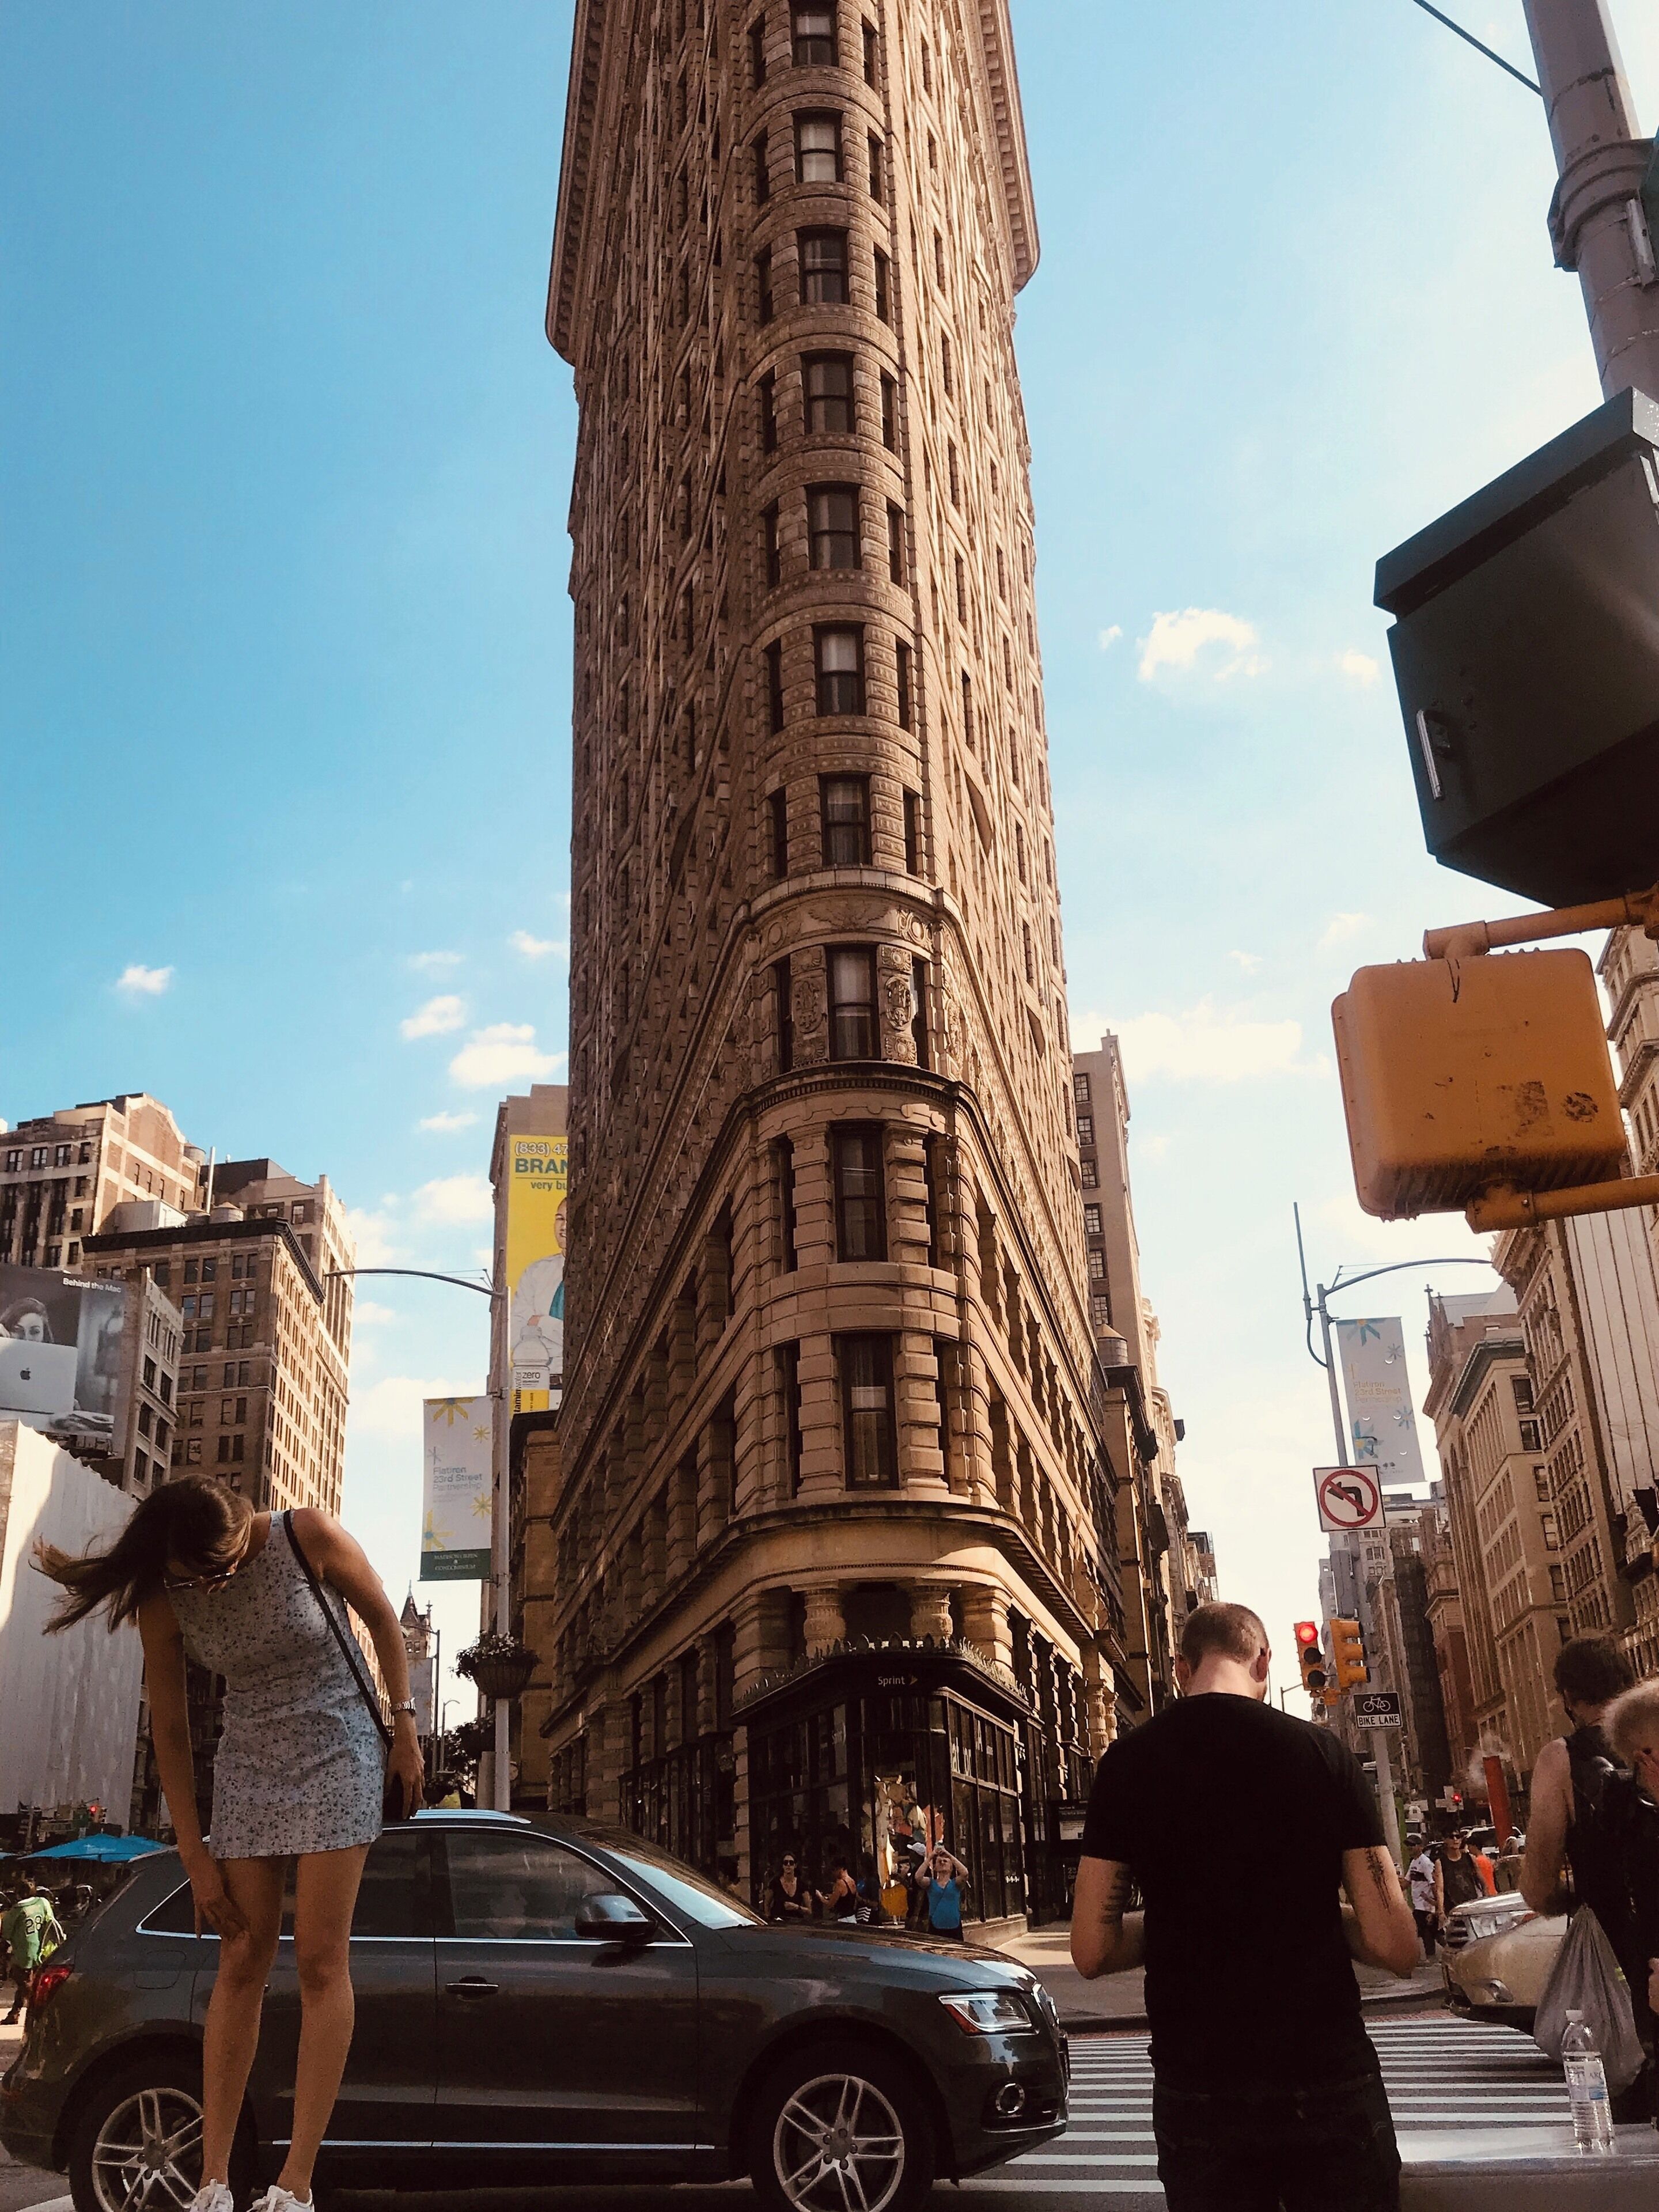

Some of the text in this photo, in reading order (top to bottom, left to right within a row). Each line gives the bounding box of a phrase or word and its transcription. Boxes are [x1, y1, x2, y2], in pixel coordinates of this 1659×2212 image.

[515, 1141, 550, 1157] (833)
[531, 1181, 552, 1191] very
[63, 1278, 122, 1293] Behind the Mac
[433, 1467, 467, 1475] Flatiron
[433, 1474, 482, 1483] 23rd Street
[878, 1676, 906, 1687] Sprint
[1358, 1715, 1399, 1726] BIKE LANE
[25, 1915, 41, 1935] 28
